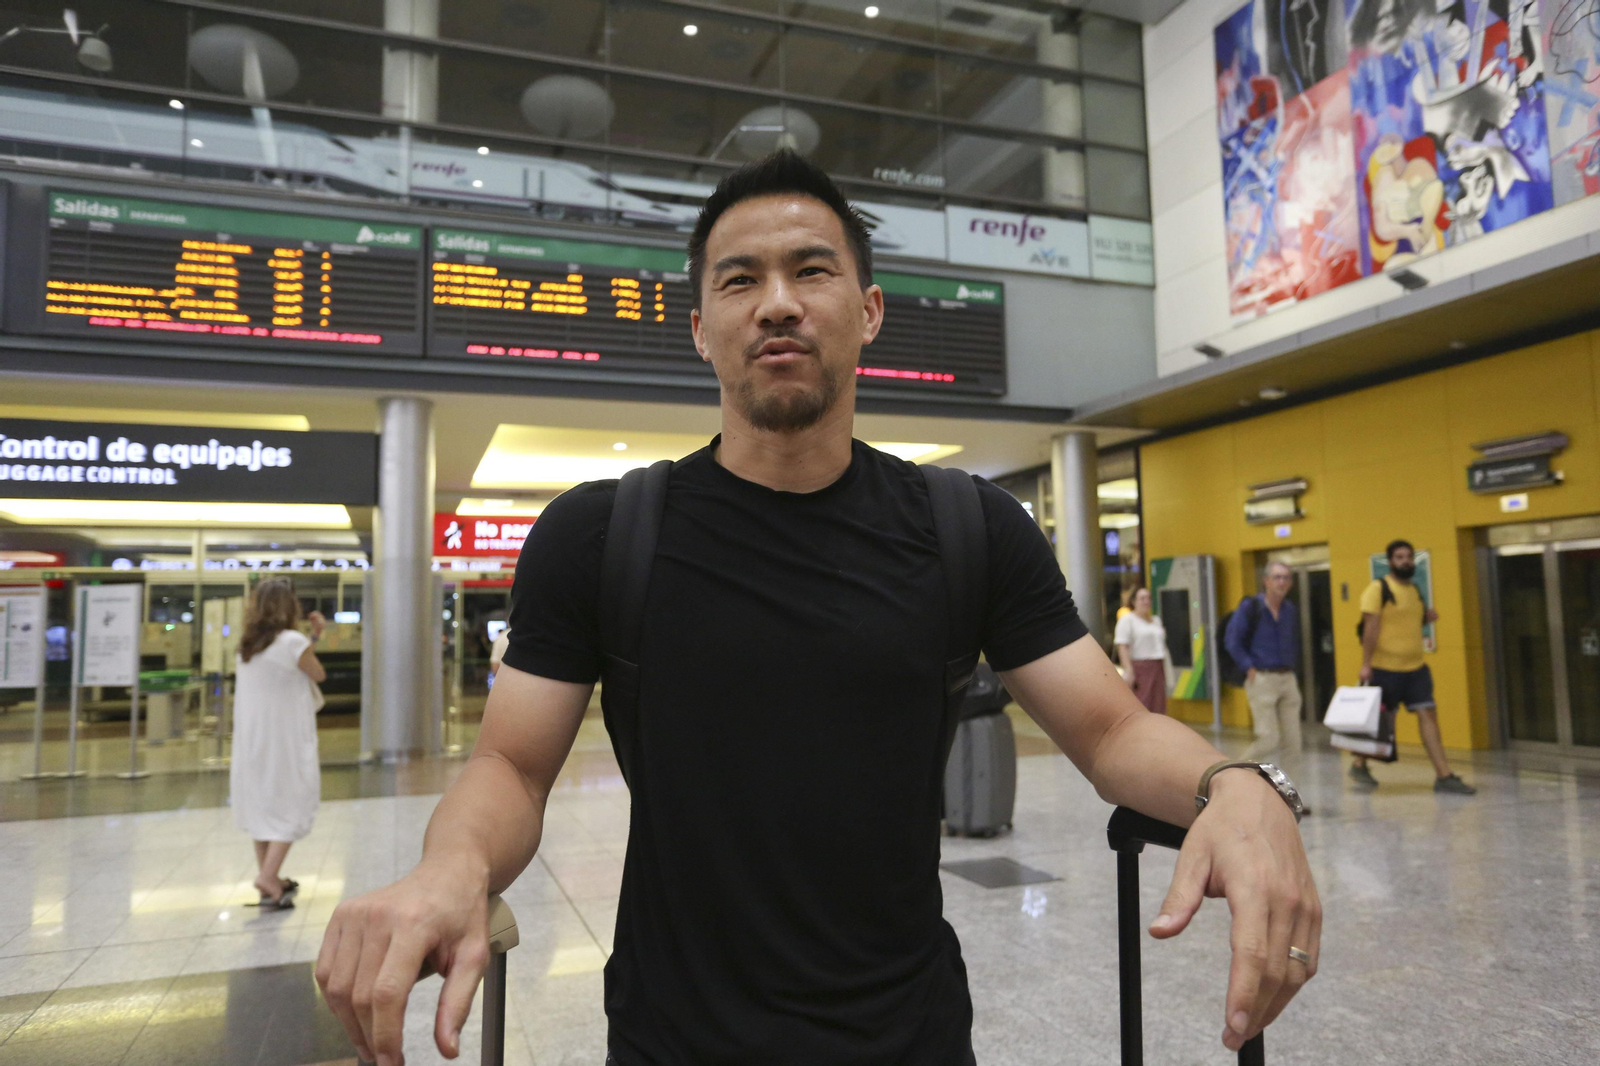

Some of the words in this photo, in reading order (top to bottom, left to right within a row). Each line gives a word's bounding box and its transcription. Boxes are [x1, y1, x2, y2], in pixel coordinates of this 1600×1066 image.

[873, 166, 946, 189] renfe.com
[54, 197, 120, 219] Salidas
[969, 214, 1046, 246] renfe
[437, 233, 491, 253] Salidas
[105, 436, 147, 463] de
[153, 438, 292, 471] equipajes
[86, 465, 178, 485] CONTROL
